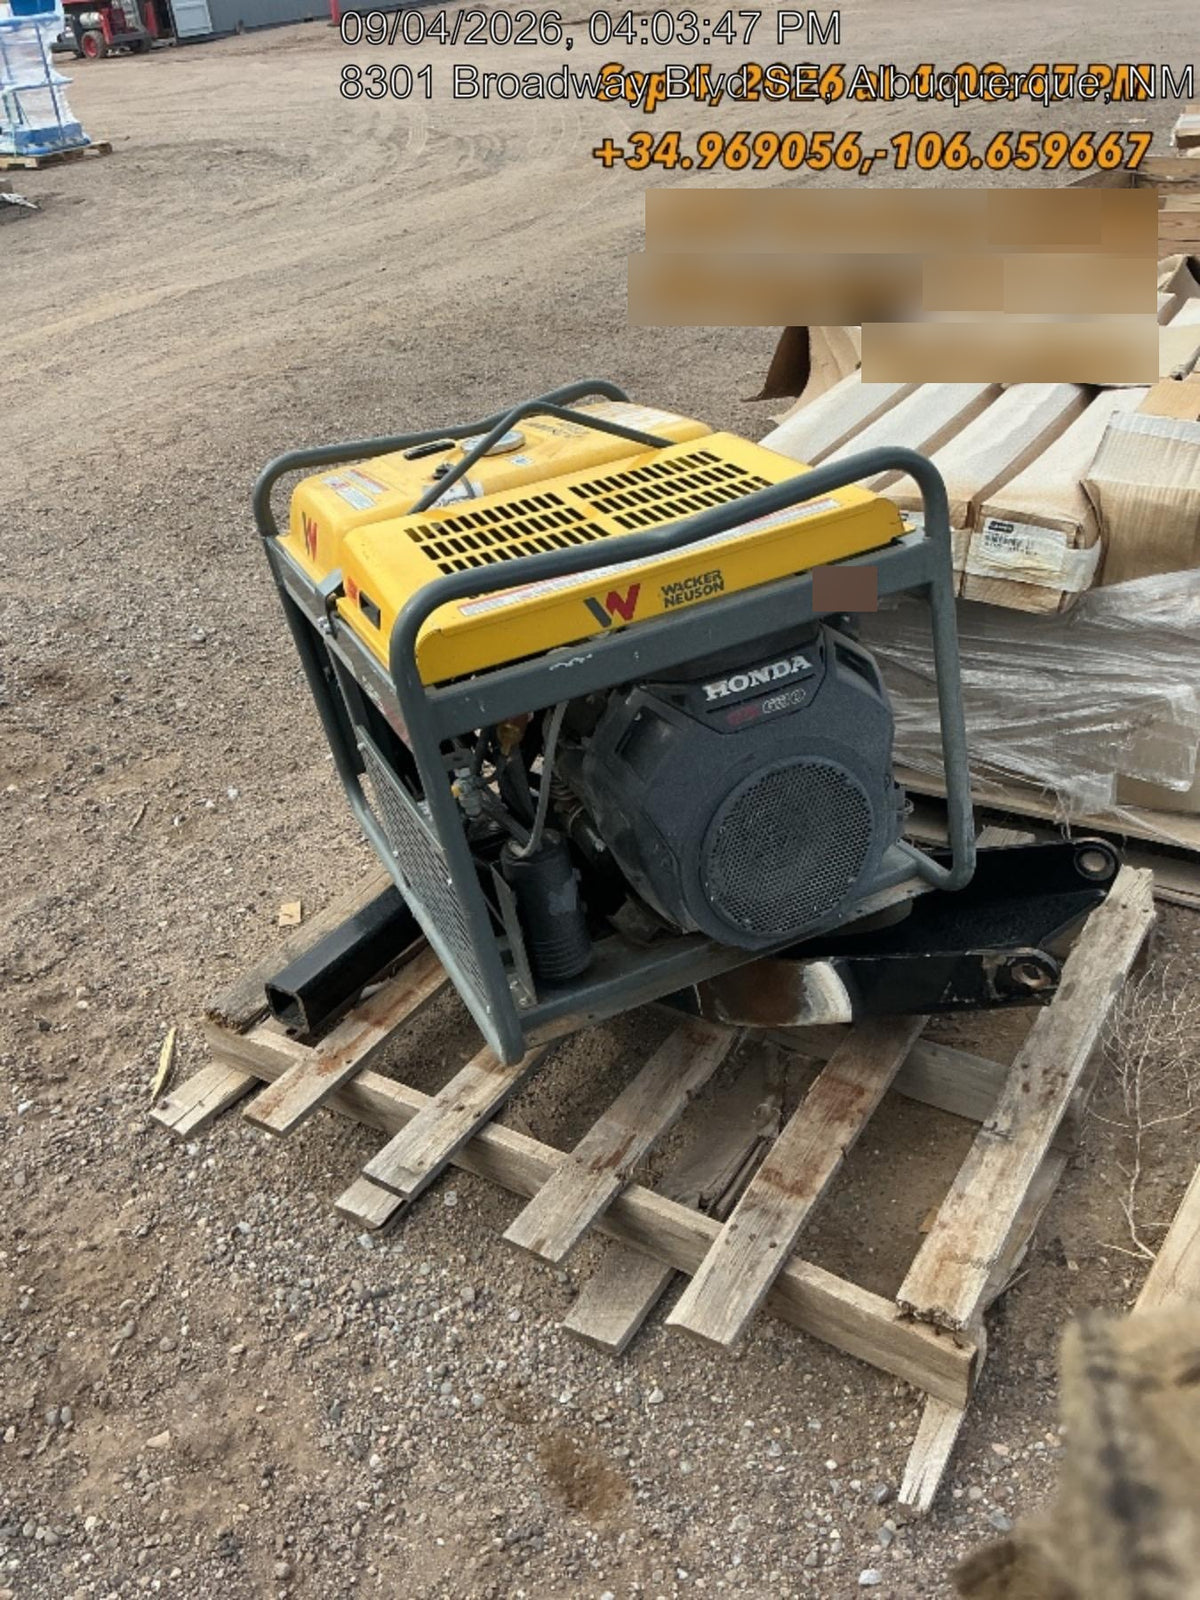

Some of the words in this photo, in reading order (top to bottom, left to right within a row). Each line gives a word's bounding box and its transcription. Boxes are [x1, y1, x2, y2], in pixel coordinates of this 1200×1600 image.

[660, 569, 723, 596] WACKER
[663, 579, 725, 609] NEUSON
[702, 655, 812, 702] HONDA
